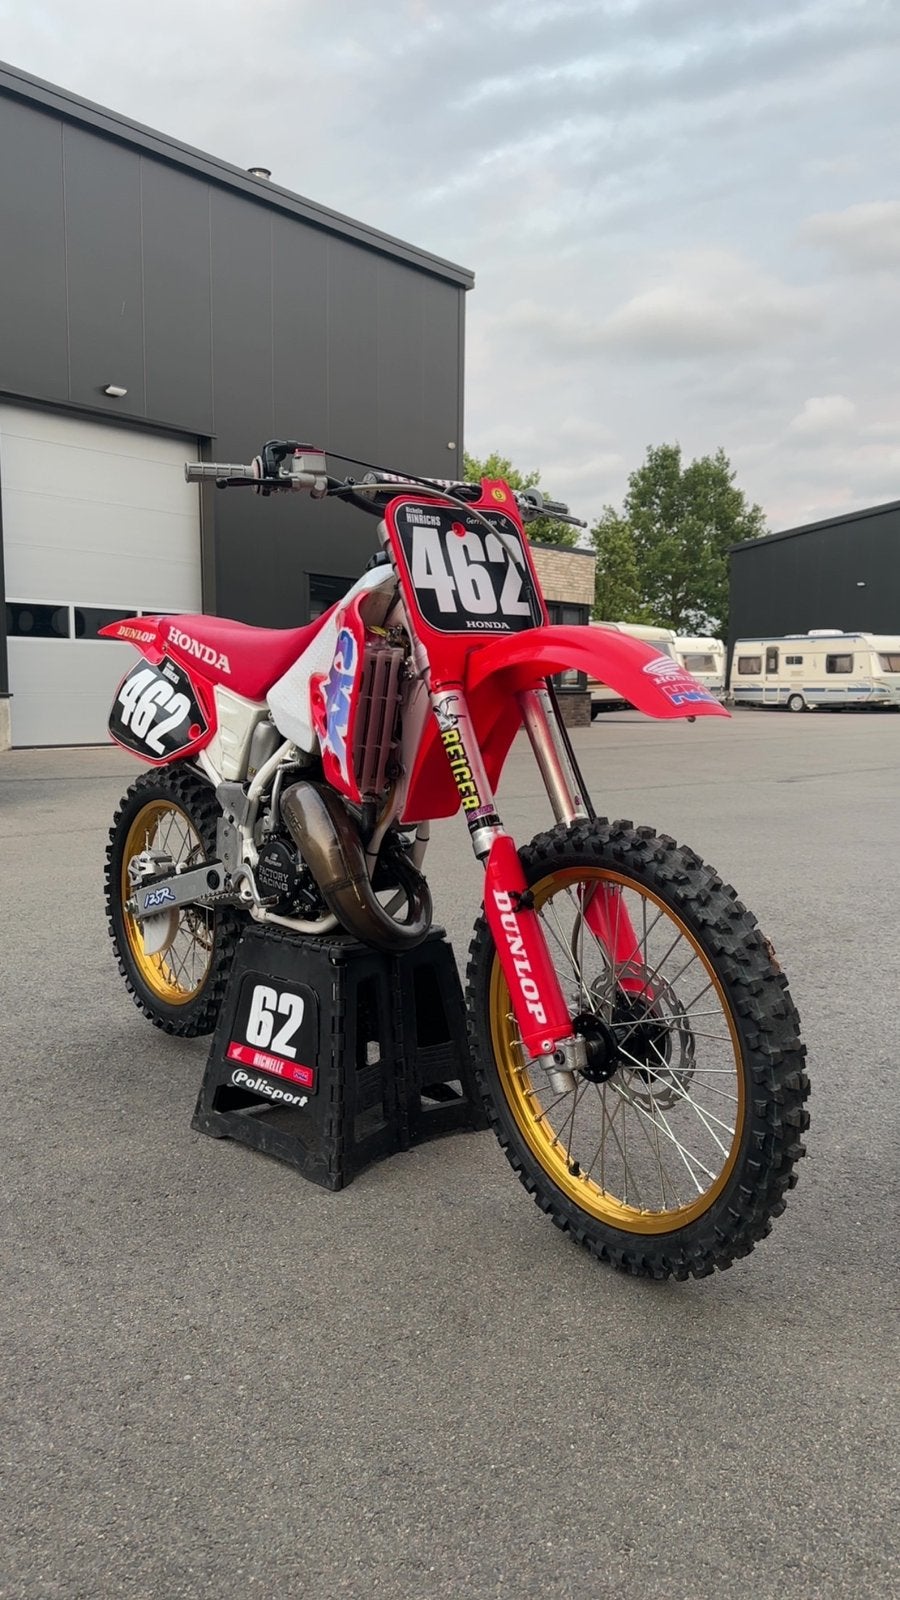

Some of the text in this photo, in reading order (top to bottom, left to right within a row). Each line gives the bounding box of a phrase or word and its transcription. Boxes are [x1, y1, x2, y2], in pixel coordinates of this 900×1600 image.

[406, 513, 441, 526] HINRICHS
[411, 526, 531, 616] 462
[117, 625, 156, 643] DUNLOP
[466, 620, 510, 630] HONDA
[167, 626, 232, 674] HONDA
[118, 668, 191, 755] 462
[441, 727, 481, 811] REIGER
[259, 865, 289, 882] FACTORY
[259, 874, 289, 891] RACING
[144, 887, 176, 909] 125R
[493, 889, 547, 1024] DUNLOP
[246, 985, 305, 1059] 62
[232, 1069, 309, 1107] Polisport
